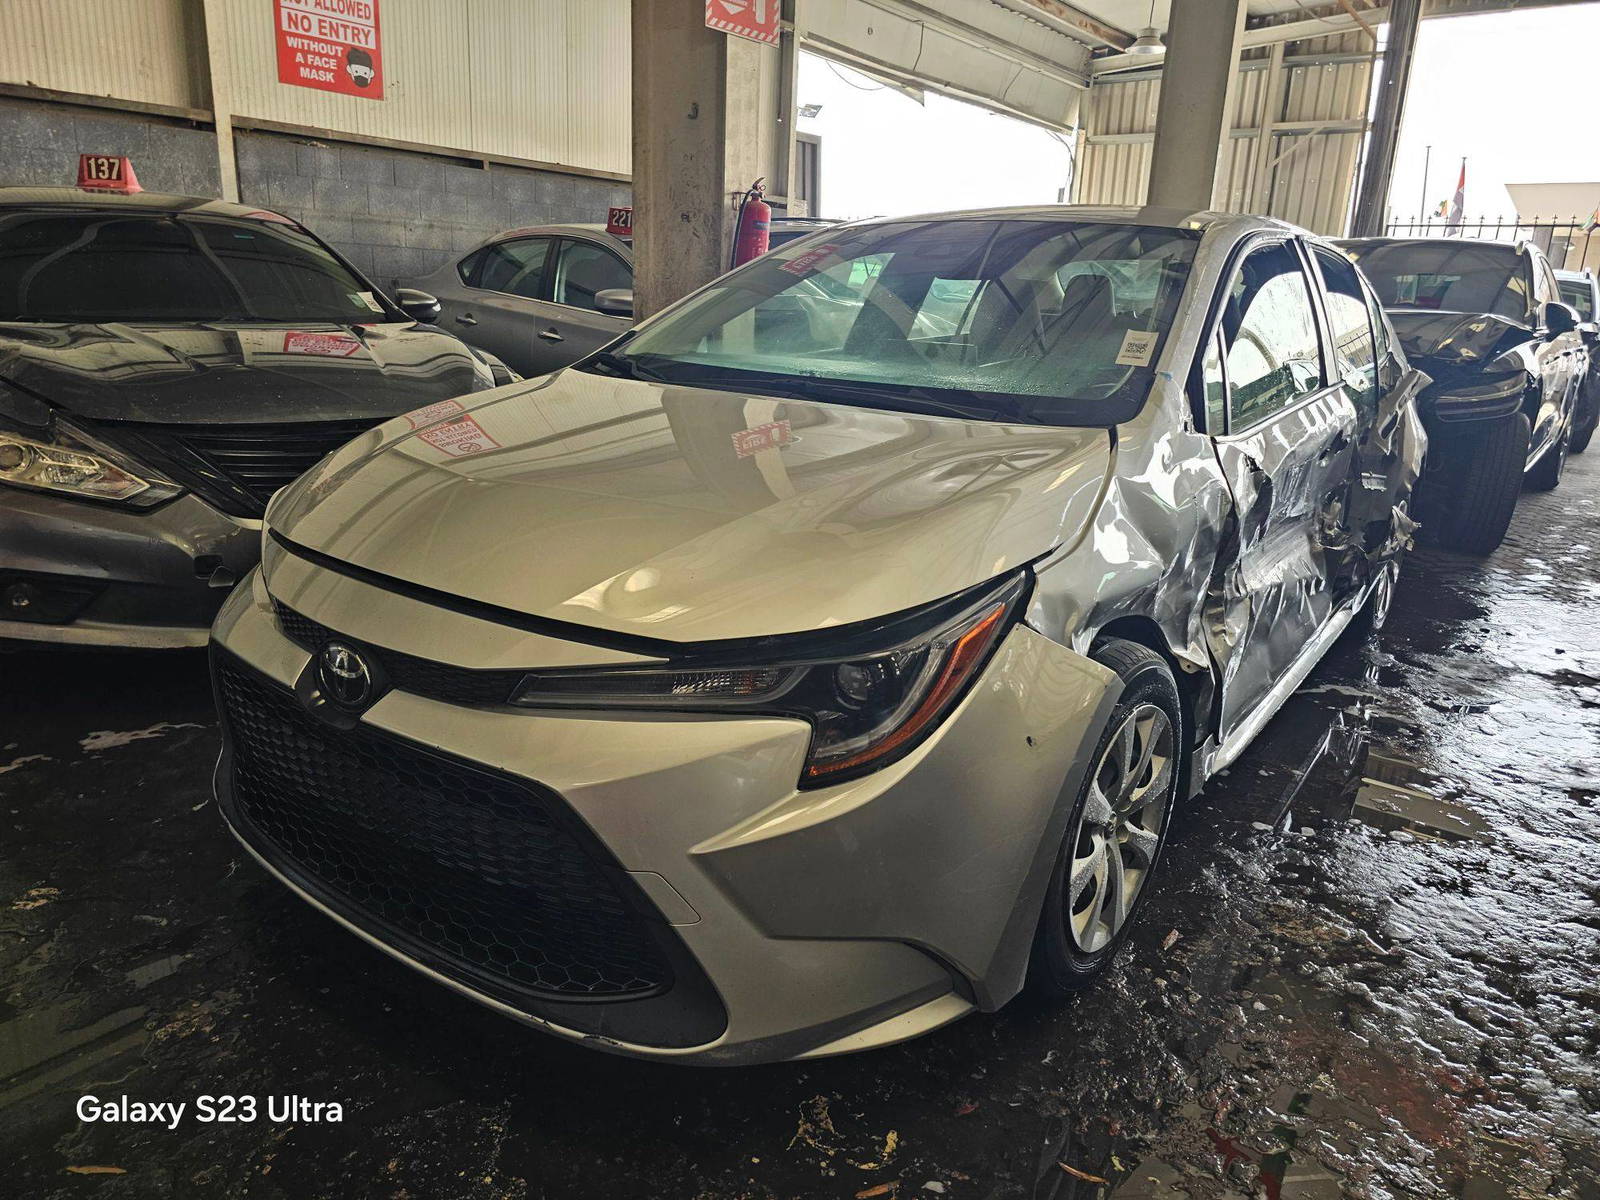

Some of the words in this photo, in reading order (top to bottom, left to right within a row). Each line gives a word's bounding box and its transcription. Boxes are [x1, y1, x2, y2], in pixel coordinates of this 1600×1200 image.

[314, 0, 372, 20] ALLOWED
[287, 12, 312, 33] NO
[318, 18, 371, 45] ENTRY
[286, 36, 344, 57] WITHOUT
[295, 52, 305, 64] A
[307, 55, 338, 70] FACE
[300, 67, 335, 83] MASK
[88, 158, 120, 180] 137
[612, 210, 631, 227] 221
